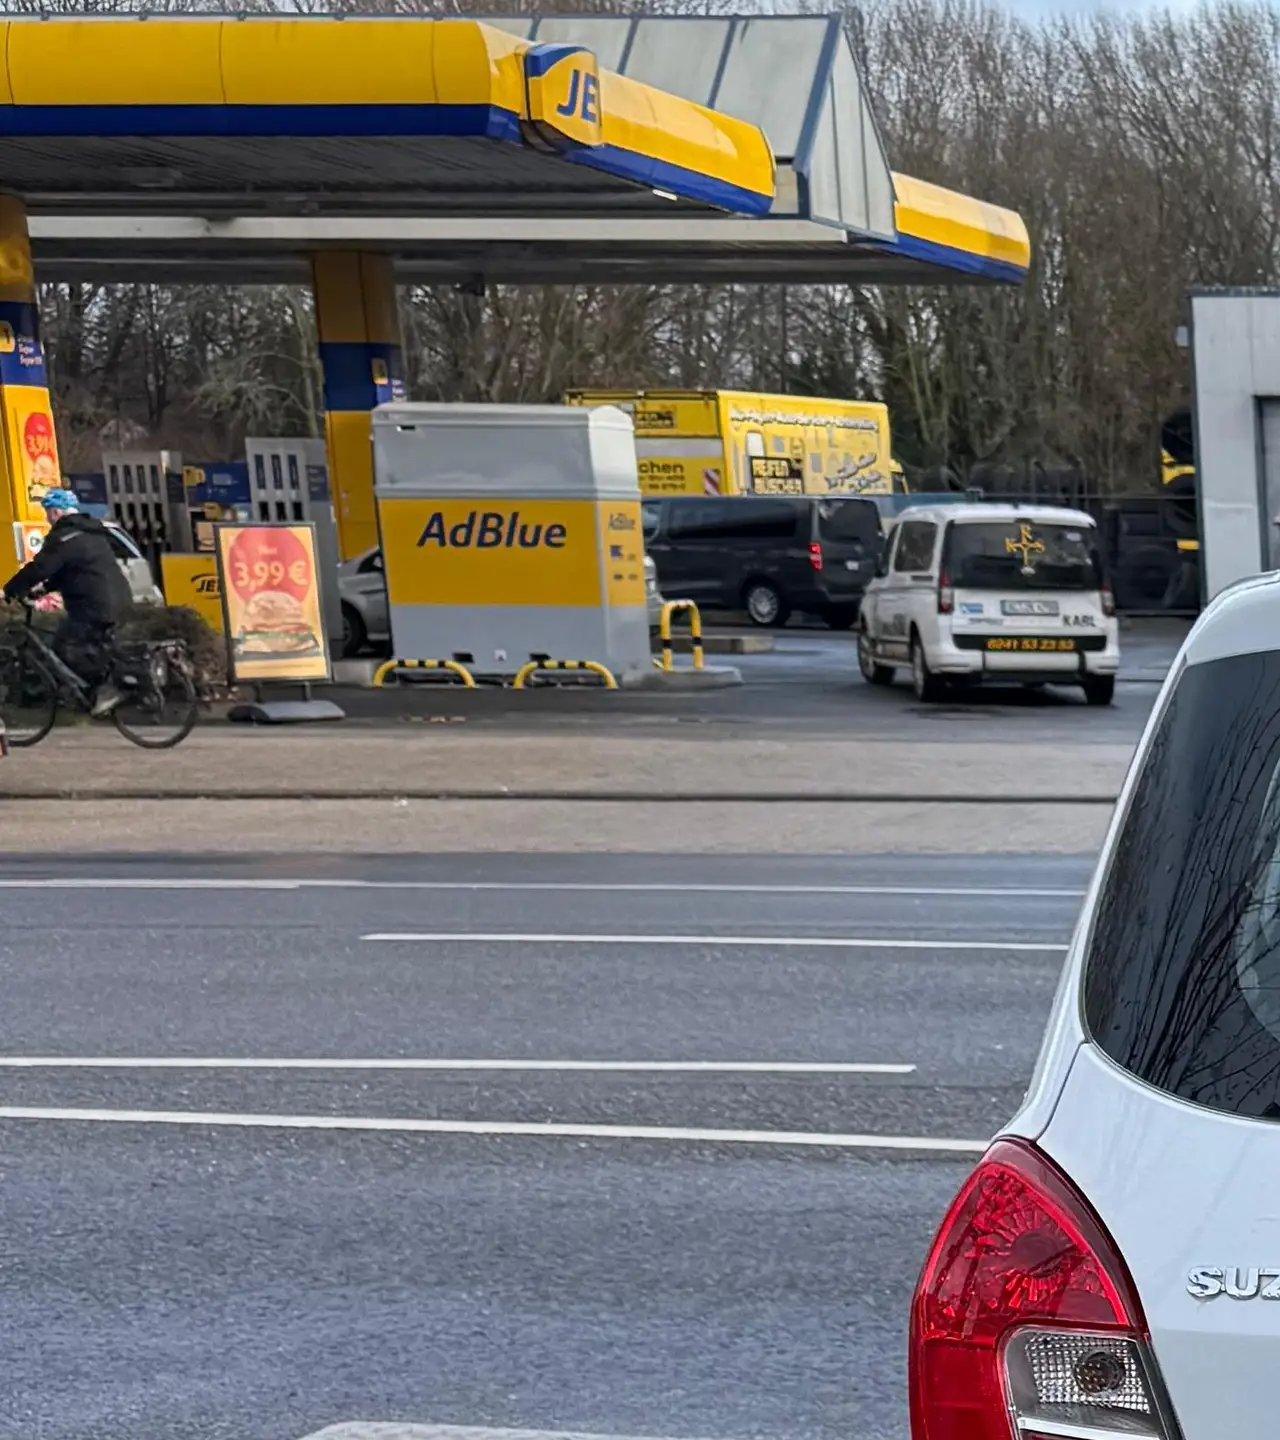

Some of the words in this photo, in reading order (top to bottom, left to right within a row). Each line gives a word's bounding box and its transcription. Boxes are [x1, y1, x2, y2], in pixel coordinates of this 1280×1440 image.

[416, 511, 567, 548] AdBlue
[234, 561, 285, 592] 3,99
[288, 560, 307, 585] €
[1062, 614, 1096, 628] KARL
